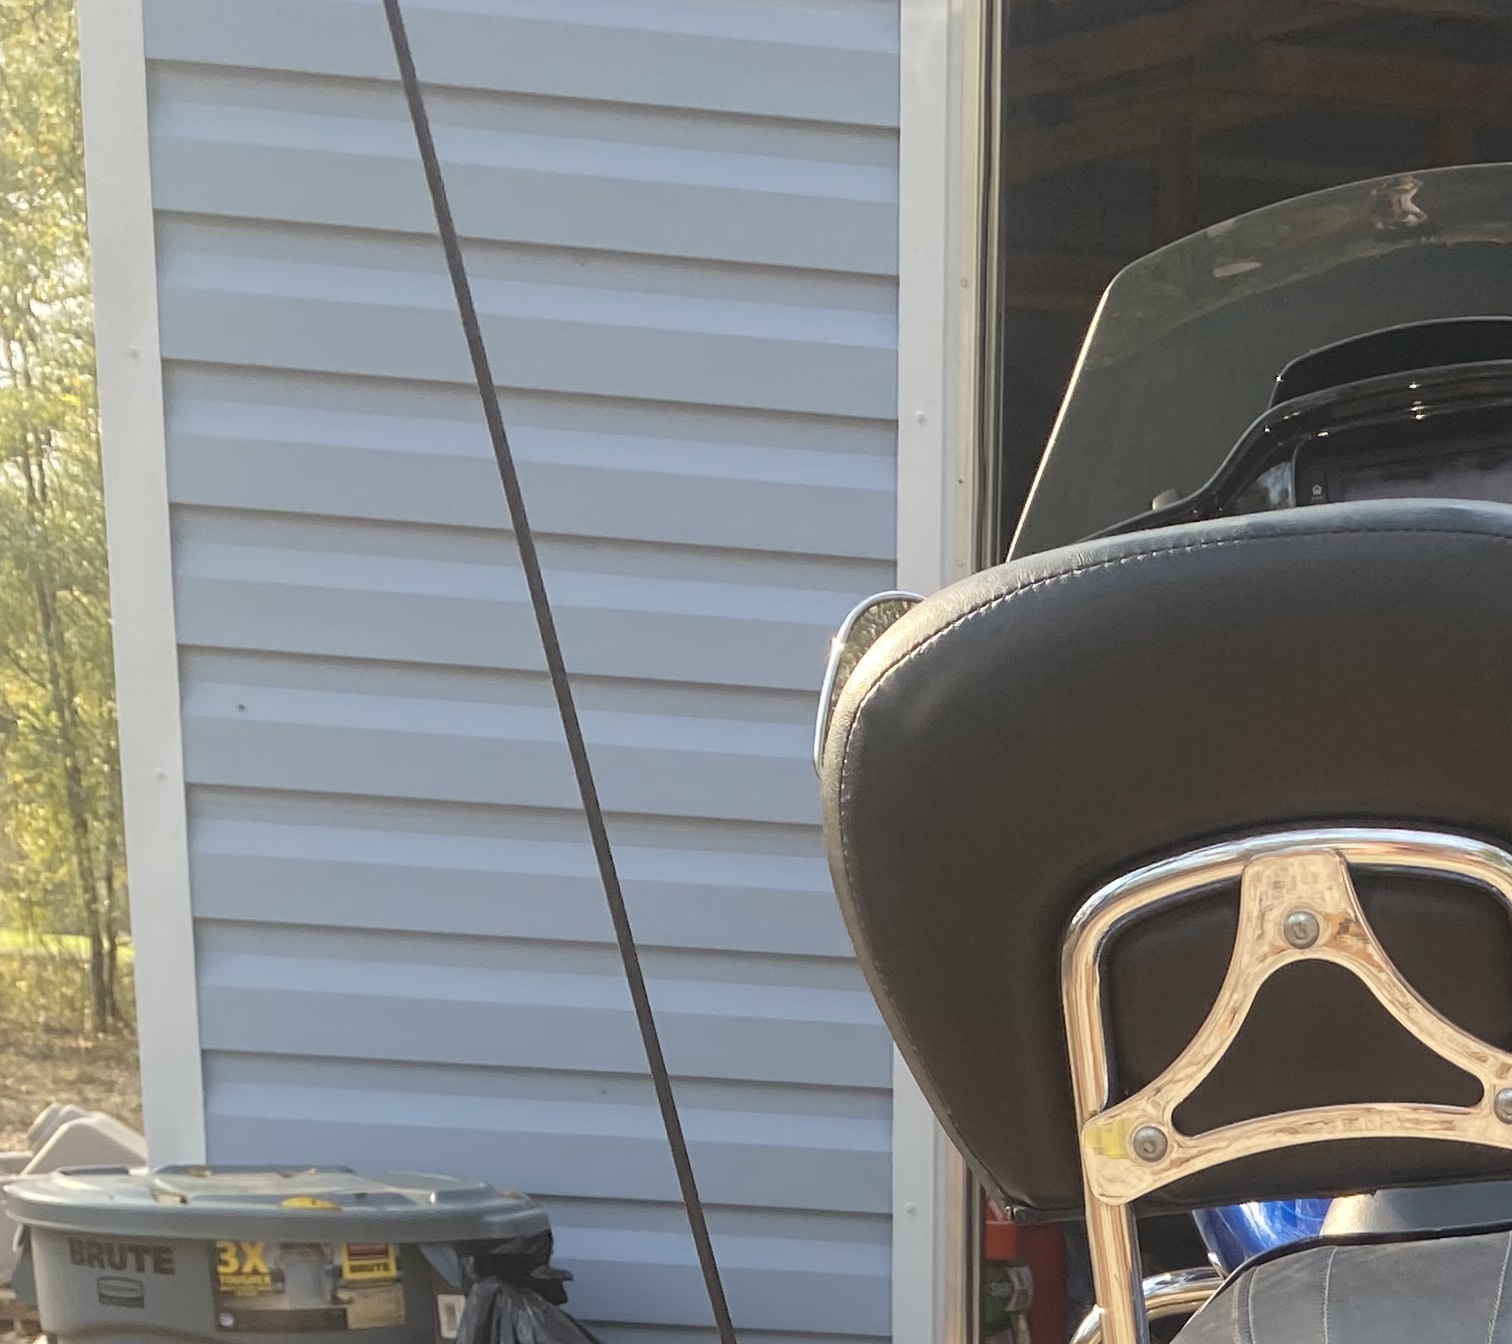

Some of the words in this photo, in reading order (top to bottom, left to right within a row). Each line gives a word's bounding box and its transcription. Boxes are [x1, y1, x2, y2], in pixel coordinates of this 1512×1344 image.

[68, 1238, 176, 1275] BRUTE
[215, 1240, 270, 1274] 3X
[349, 1262, 390, 1273] BRUTE
[218, 1274, 272, 1287] TOUGHER
